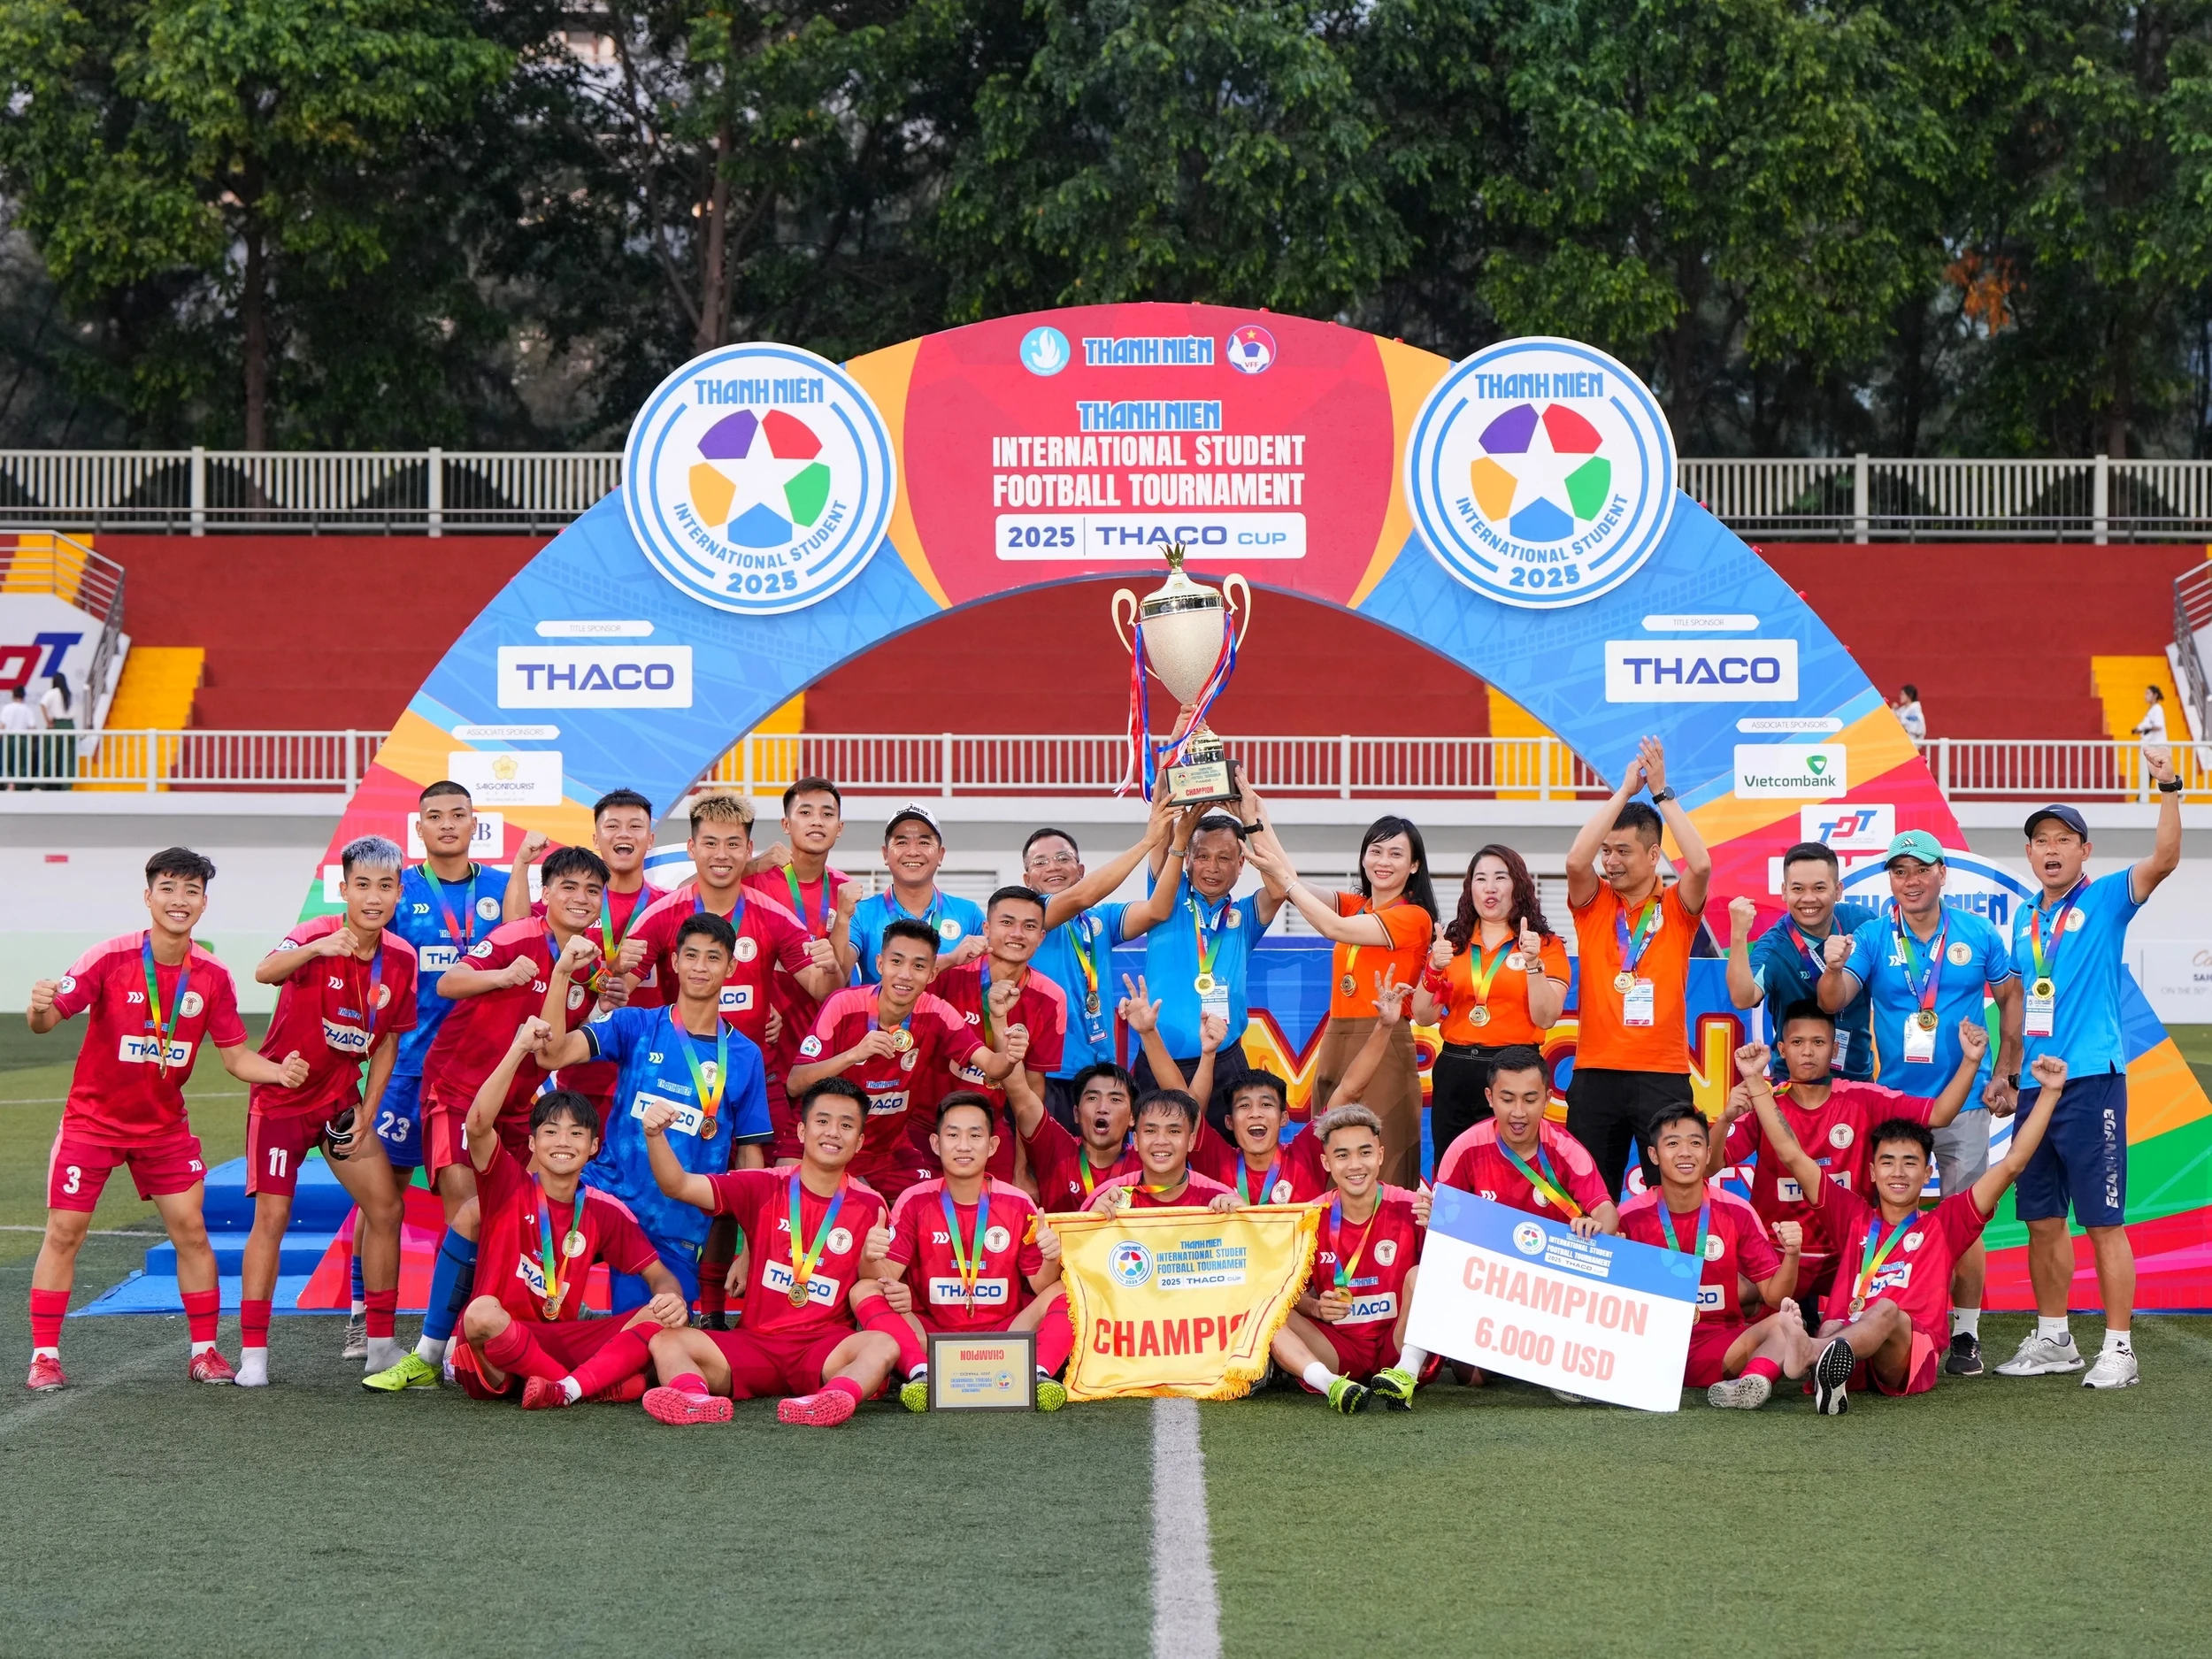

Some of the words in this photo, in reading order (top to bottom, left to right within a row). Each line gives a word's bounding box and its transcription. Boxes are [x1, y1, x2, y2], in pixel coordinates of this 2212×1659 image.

[1084, 339, 1160, 364] THANH
[695, 379, 769, 404] THANH
[1475, 373, 1548, 398] THANH
[1079, 403, 1160, 430] THANH
[993, 436, 1187, 467] INTERNATIONAL
[1195, 434, 1306, 466] STUDENT
[993, 474, 1121, 507] FOOTBALL
[1128, 472, 1305, 506] TOURNAMENT
[673, 503, 787, 569] INTERNATIONAL
[790, 500, 847, 561] STUDENT
[1008, 526, 1075, 548] 2025
[1095, 526, 1227, 545] THACO
[1238, 532, 1286, 545] CUP
[1455, 496, 1569, 563] INTERNATIONAL
[1572, 494, 1628, 555] STUDENT
[726, 571, 798, 594] 2025
[1509, 565, 1580, 588] 2025
[570, 624, 587, 633] TITLE
[588, 624, 621, 633] SPONSOR
[516, 664, 674, 691] THACO
[1623, 657, 1780, 685] THACO
[1790, 720, 1829, 729] SPONSORS
[1186, 786, 1214, 796] CHAMPION
[1744, 774, 1837, 787] Vietcombank
[1818, 810, 1878, 842] TDT
[640, 1100, 695, 1127] TCO
[377, 1111, 411, 1142] 23
[268, 1147, 288, 1178] 11
[63, 1165, 82, 1194] 3
[1156, 1248, 1213, 1263] INTERNATIONAL
[1216, 1247, 1247, 1259] STUDENT
[1180, 1240, 1205, 1250] THANH
[1547, 1244, 1574, 1258] FOOTBALL
[1574, 1251, 1611, 1267] TOURNAMENT
[1548, 1235, 1588, 1253] INTERNATIONAL
[1589, 1245, 1614, 1258] STUDENT
[1156, 1262, 1194, 1274] FOOTBALL
[1196, 1258, 1247, 1272] TOURNAMENT
[1548, 1255, 1562, 1263] 2025
[1565, 1260, 1593, 1271] THACO
[770, 1268, 831, 1297] THCO
[1161, 1278, 1181, 1286] 2025
[1187, 1275, 1225, 1285] THACO
[1463, 1256, 1649, 1337] CHAMPION
[960, 1349, 1004, 1361] CHAMPION
[1474, 1317, 1555, 1366] 6.000
[1562, 1340, 1616, 1381] USD
